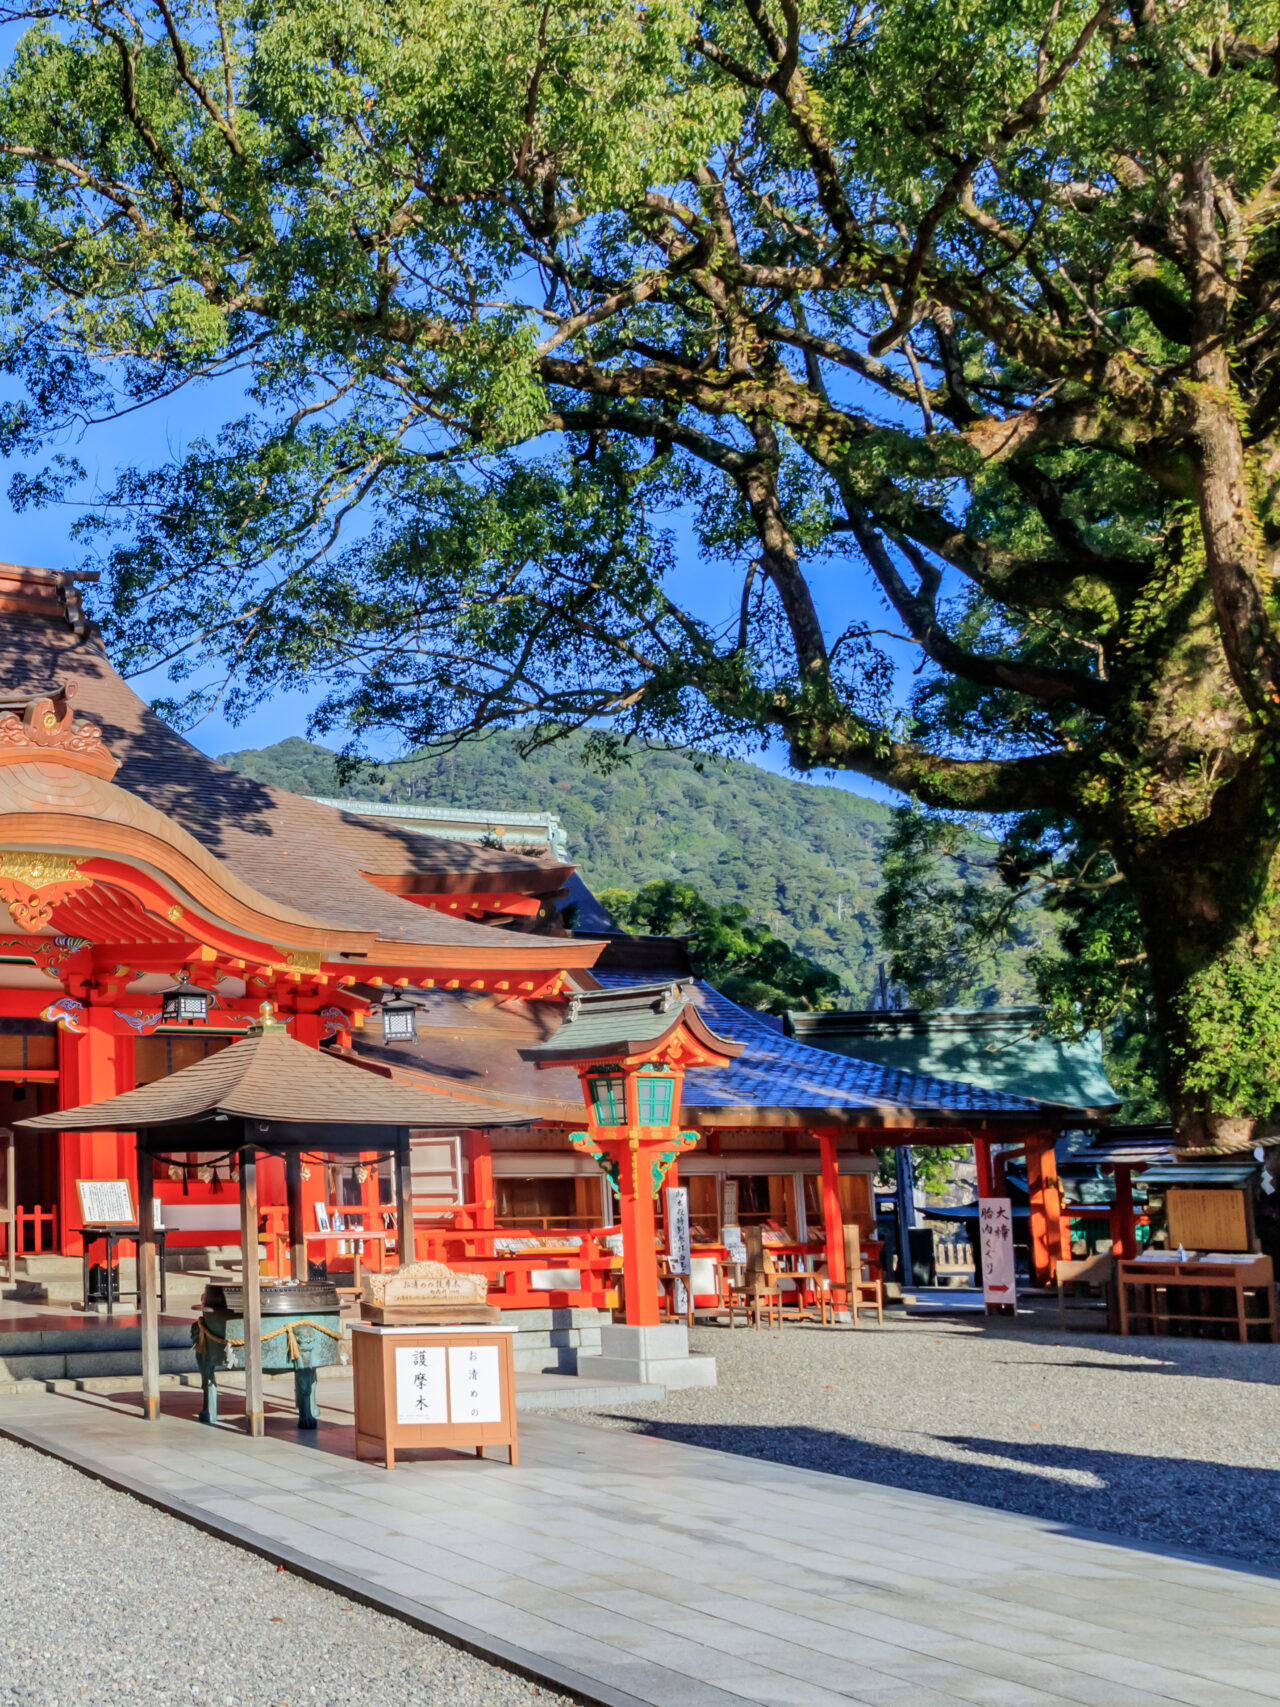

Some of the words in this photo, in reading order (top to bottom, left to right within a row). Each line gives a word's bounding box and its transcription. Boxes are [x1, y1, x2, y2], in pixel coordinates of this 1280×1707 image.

[981, 1207, 995, 1275] 胎内くぐり
[412, 1350, 429, 1411] 護摩木
[468, 1350, 479, 1417] お清めの
